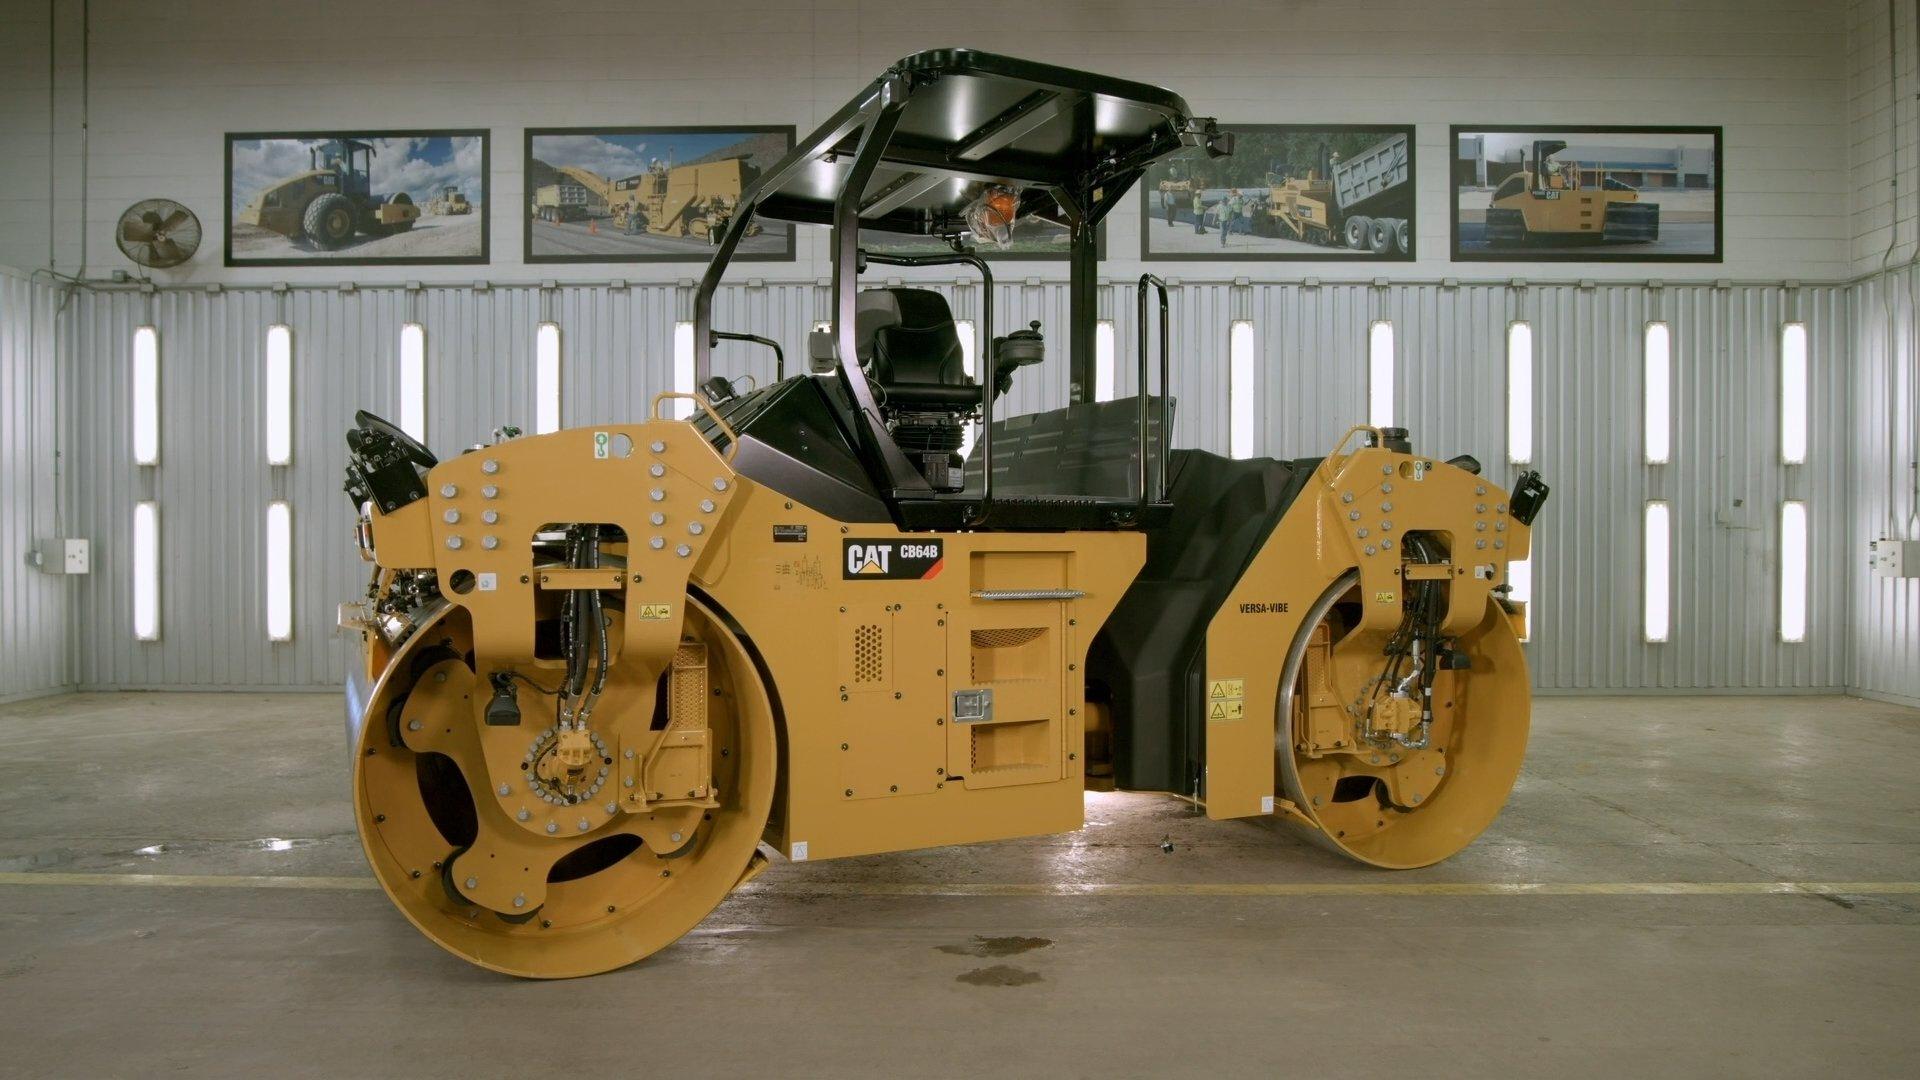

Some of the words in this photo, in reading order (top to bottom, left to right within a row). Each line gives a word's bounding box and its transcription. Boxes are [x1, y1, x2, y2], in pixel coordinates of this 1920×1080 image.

[900, 545, 938, 558] CB64B
[848, 544, 892, 574] CAT
[1240, 603, 1288, 613] VERSA-VIBE
